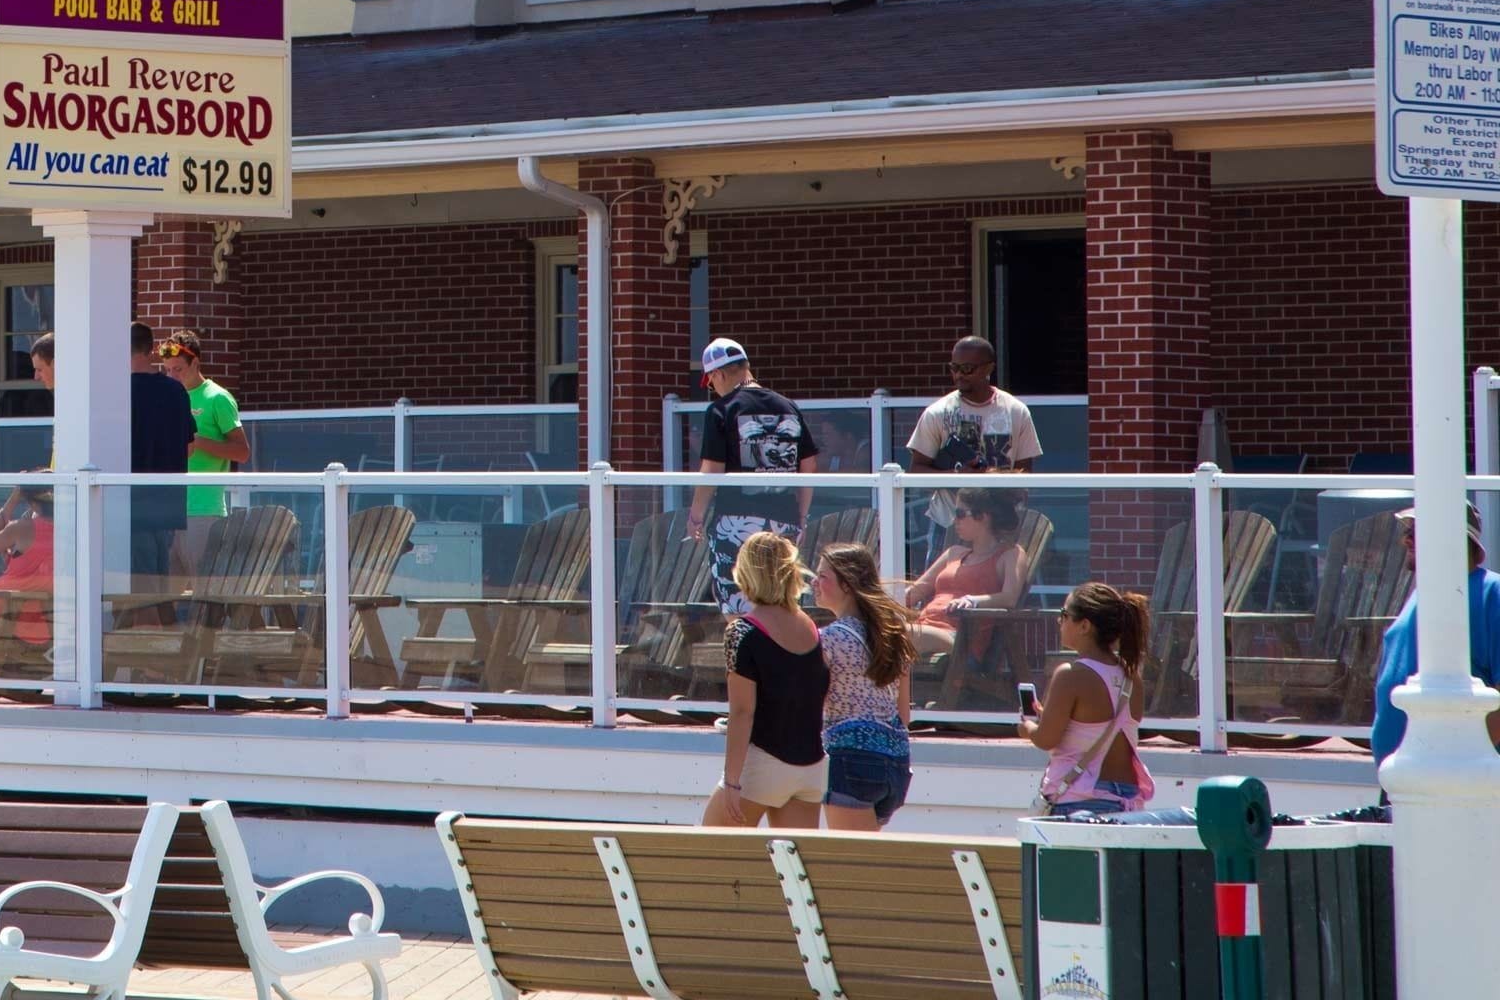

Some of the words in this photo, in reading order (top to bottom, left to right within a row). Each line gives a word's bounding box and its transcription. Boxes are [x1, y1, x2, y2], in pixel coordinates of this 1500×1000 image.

[173, 0, 220, 26] GRILL
[1417, 1, 1454, 11] boardwalk
[1429, 22, 1463, 39] Bikes
[1404, 40, 1458, 59] Memorial
[1463, 45, 1485, 64] Day
[42, 53, 110, 88] Paul
[128, 57, 235, 94] Revere
[1428, 63, 1452, 79] thru
[1457, 65, 1492, 81] Labor
[1415, 82, 1442, 98] 2:00
[1447, 84, 1465, 100] AM
[3, 81, 273, 146] SMORGASBORD
[1433, 115, 1469, 125] Other
[1475, 118, 1500, 127] Tim
[1424, 125, 1442, 134] No
[1398, 144, 1466, 157] Springfest
[1471, 150, 1496, 158] and
[1452, 137, 1497, 149] Except
[6, 142, 39, 171] All
[42, 151, 85, 180] you
[90, 152, 129, 176] can
[133, 152, 169, 177] eat
[182, 156, 272, 196] $12.99
[1408, 166, 1438, 176] 2:00
[1444, 168, 1464, 177] AM
[1468, 160, 1494, 169] thru
